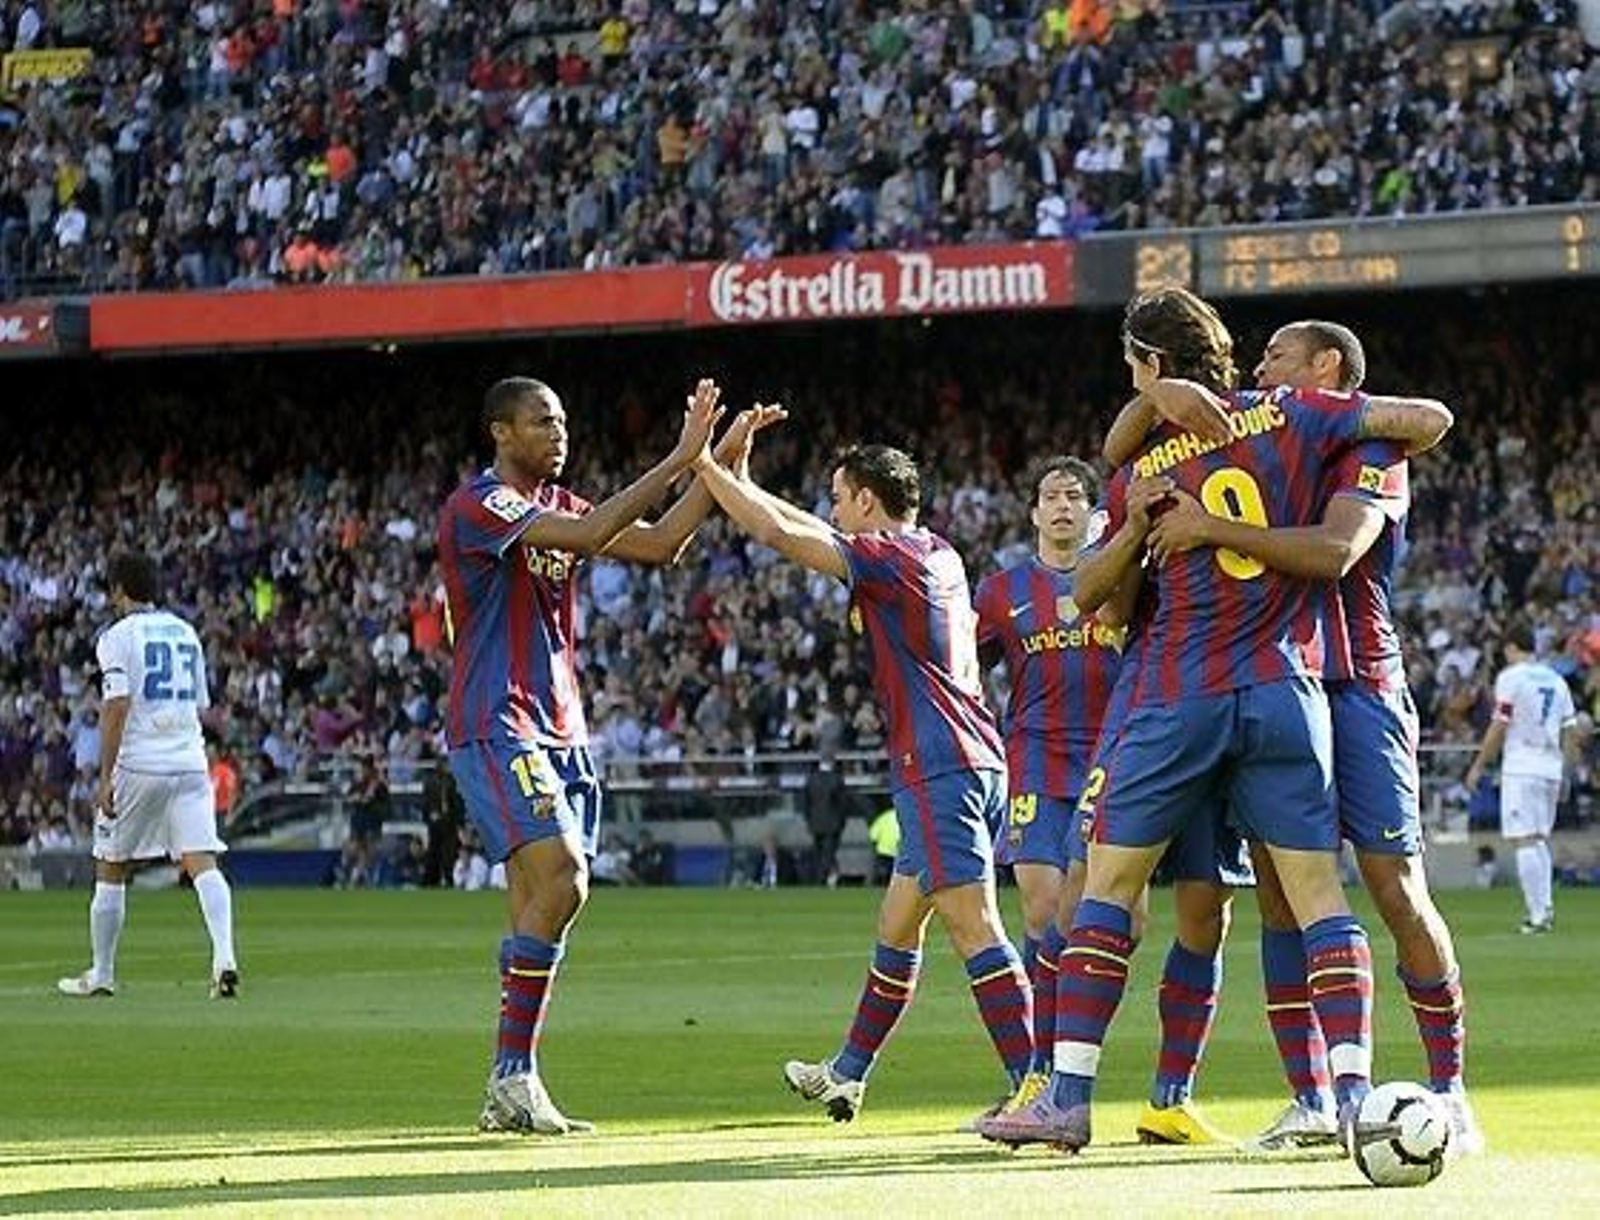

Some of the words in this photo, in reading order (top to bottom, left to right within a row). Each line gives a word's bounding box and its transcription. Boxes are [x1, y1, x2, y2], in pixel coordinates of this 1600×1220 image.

[1564, 215, 1583, 241] 0
[1224, 264, 1257, 289] FC
[1567, 246, 1580, 270] 1
[709, 259, 885, 322] Estrella
[895, 250, 1048, 313] Damm
[1201, 467, 1269, 580] 9
[1021, 621, 1092, 654] unicef
[143, 641, 198, 700] 23
[1538, 686, 1556, 727] 7
